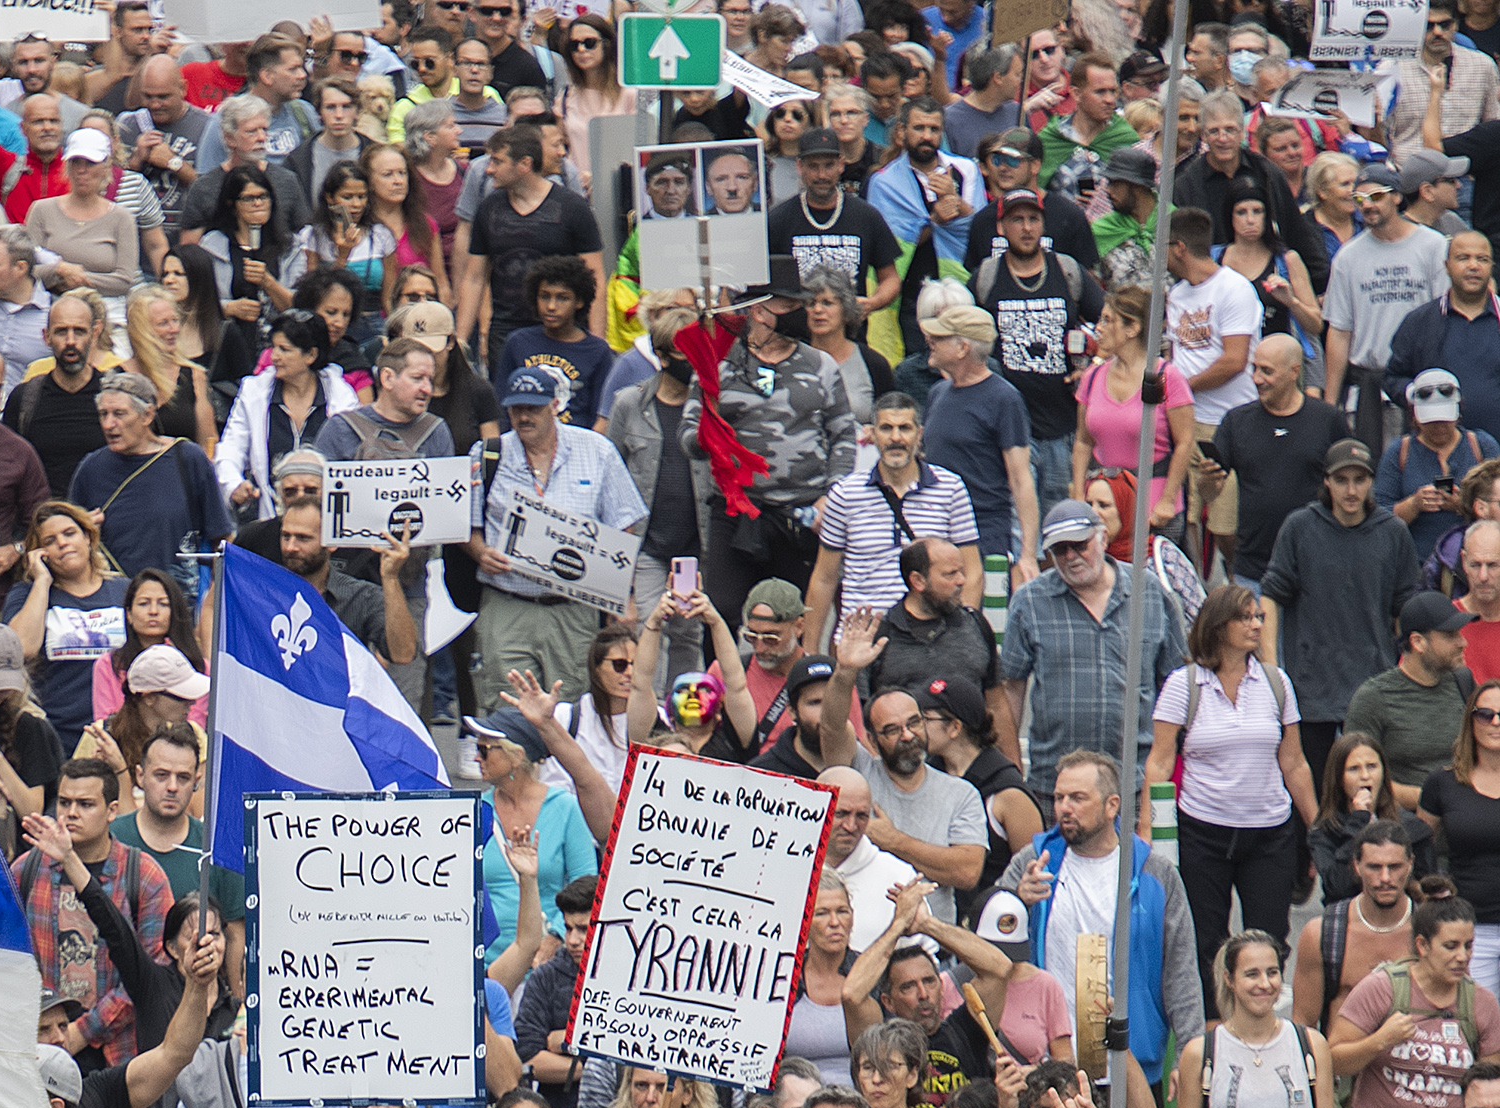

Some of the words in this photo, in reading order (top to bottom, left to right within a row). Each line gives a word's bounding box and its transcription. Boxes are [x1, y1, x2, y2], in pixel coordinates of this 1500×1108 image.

[328, 465, 394, 478] trudeau
[375, 487, 430, 502] legault
[513, 490, 569, 526] trudeau
[545, 525, 596, 554] legault
[683, 779, 709, 802] DE
[711, 789, 731, 806] LA
[734, 788, 824, 824] POPULATION
[263, 811, 321, 840] THE
[332, 815, 421, 841] POWER
[440, 813, 473, 836] OF
[637, 804, 729, 841] BANNIE
[751, 825, 778, 849] DE
[787, 834, 815, 857] LA
[296, 846, 457, 892] CHOICE
[630, 843, 738, 878] SOCIÉTÉ
[621, 886, 680, 918] C'EST
[692, 905, 741, 930] CELA
[757, 920, 782, 941] LA
[268, 949, 339, 979] mRNA
[588, 917, 798, 1003] TYRANNIE
[279, 986, 435, 1010] EXPERIMENTAL
[614, 995, 741, 1030] GOUVERNEMENT
[282, 1015, 400, 1041] GENETIC
[579, 1033, 607, 1049] ET
